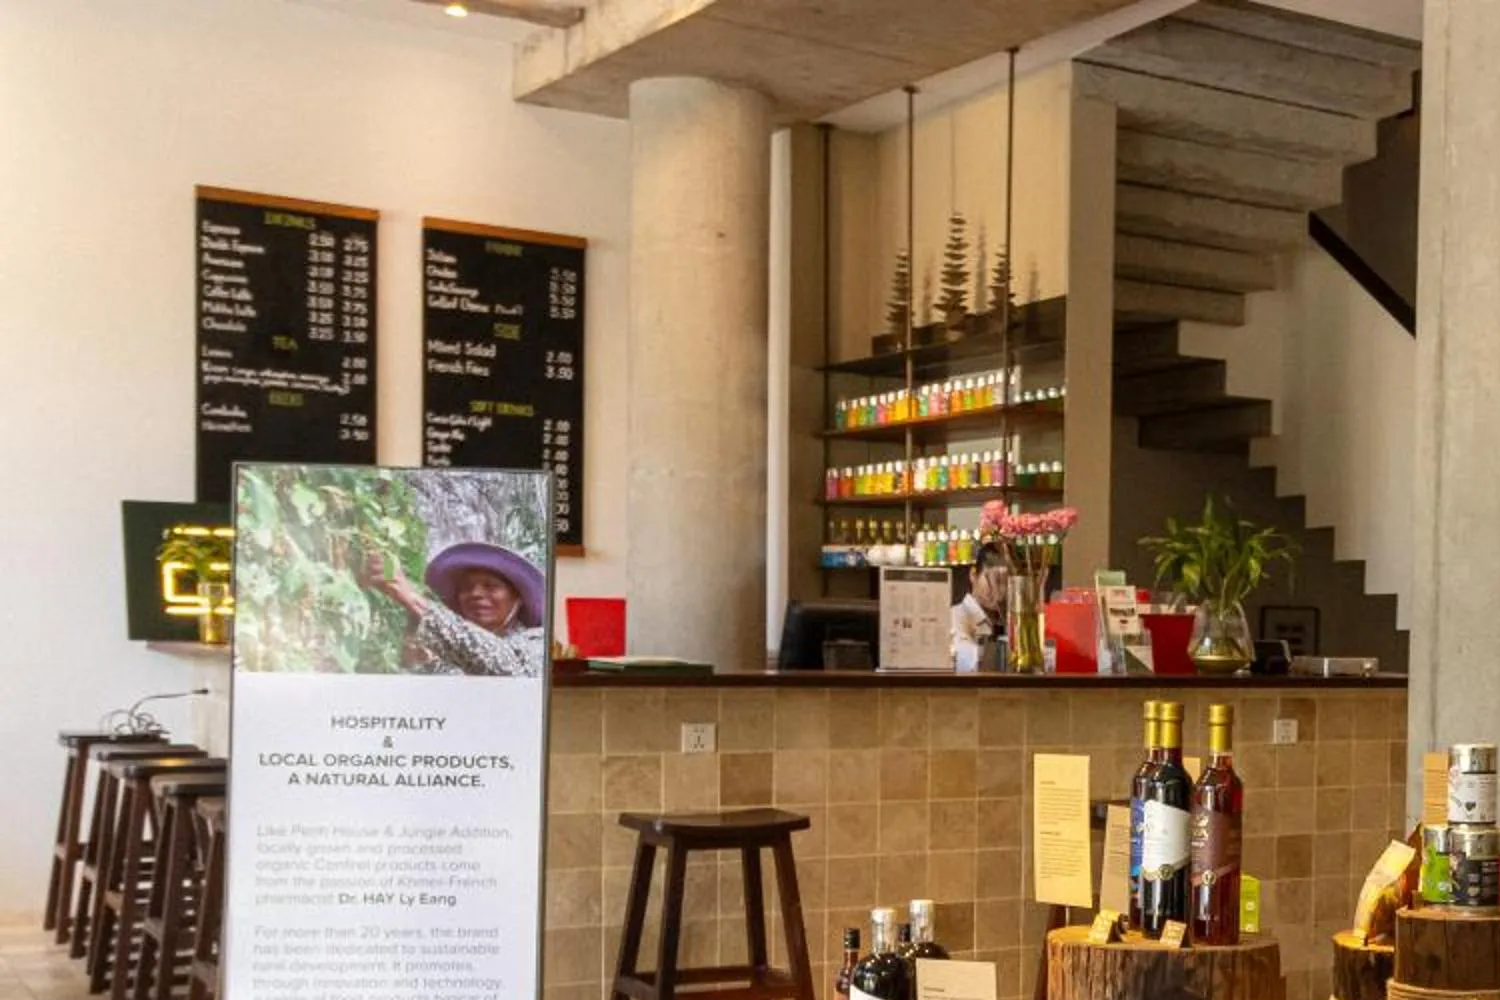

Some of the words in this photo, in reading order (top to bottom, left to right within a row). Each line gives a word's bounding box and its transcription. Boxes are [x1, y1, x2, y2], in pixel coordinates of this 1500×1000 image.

[331, 716, 447, 731] HOSPITALITY
[382, 736, 393, 748] &
[259, 753, 316, 767] LOCAL
[323, 753, 408, 768] ORGANIC
[411, 755, 515, 771] PRODUCTS,
[288, 773, 301, 785] A
[306, 773, 389, 786] NATURAL
[395, 774, 486, 788] ALLIANCE.
[398, 826, 446, 840] Jungle
[388, 844, 462, 858] processed
[375, 860, 436, 874] products
[441, 862, 481, 872] come
[292, 877, 316, 888] the
[363, 893, 395, 905] HAY
[399, 893, 415, 908] Ly
[420, 893, 457, 908] Eang
[254, 926, 278, 938] For
[283, 928, 320, 938] more
[324, 927, 357, 938] than
[359, 926, 380, 939] 20
[430, 927, 454, 938] the
[457, 927, 499, 938] brand
[253, 944, 279, 955] has
[284, 944, 321, 955] been
[326, 944, 397, 955] dedicated
[401, 945, 416, 955] to
[420, 944, 500, 955] sustainable
[252, 978, 308, 992] through
[313, 979, 387, 989] innovation
[393, 978, 419, 989] and
